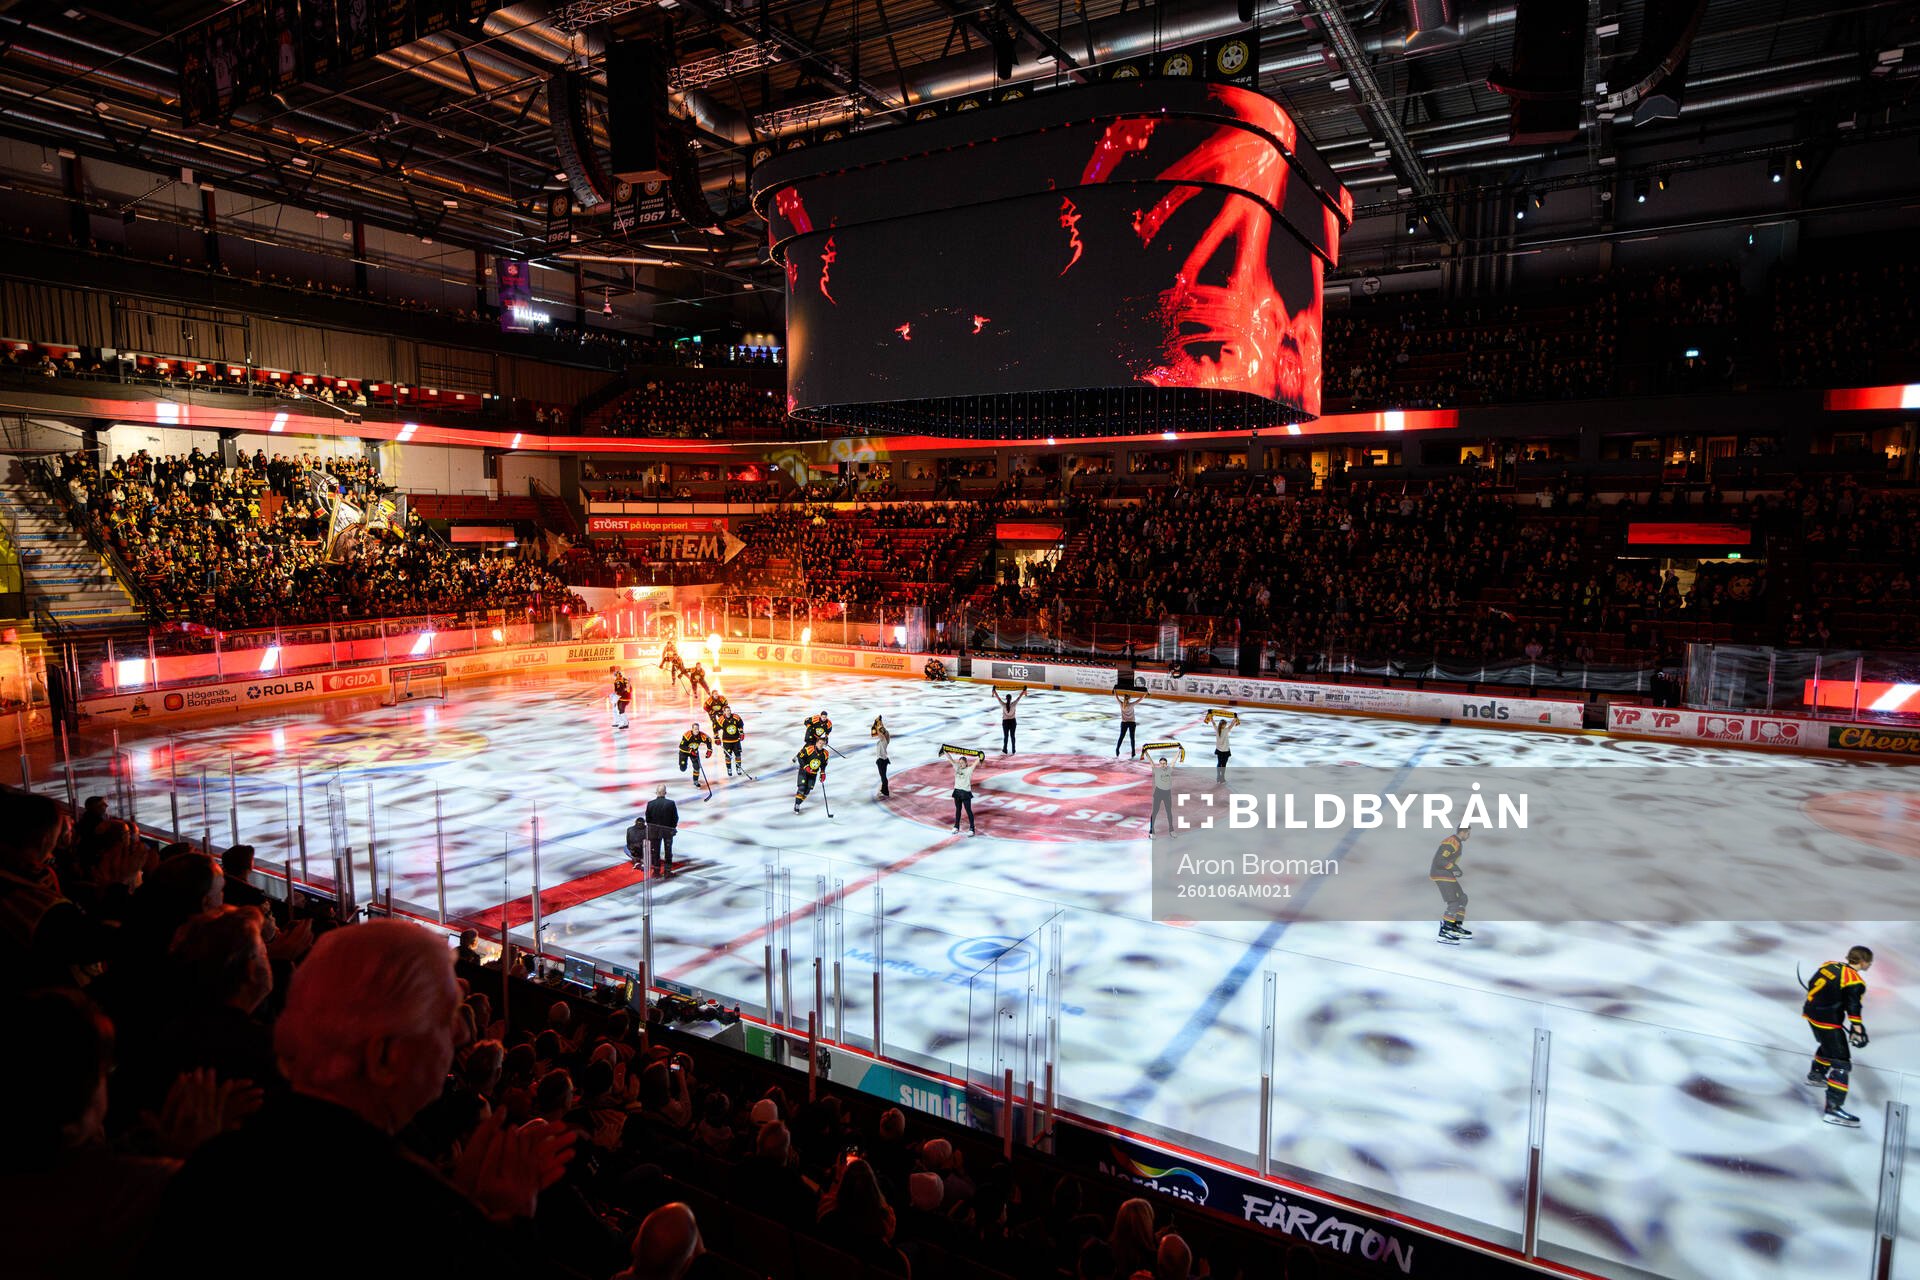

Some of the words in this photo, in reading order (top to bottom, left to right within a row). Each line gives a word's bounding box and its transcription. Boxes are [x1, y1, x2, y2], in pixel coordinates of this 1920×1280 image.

[639, 210, 666, 223] 1967
[612, 217, 636, 231] 1966
[593, 518, 629, 529] STÖRST
[630, 519, 641, 531] på
[643, 519, 662, 531] låga
[1008, 667, 1029, 677] NKB
[345, 673, 376, 687] GIDA
[187, 689, 230, 701] Höganäs
[263, 681, 315, 697] ROLBA
[1150, 679, 1178, 691] EN
[1185, 682, 1231, 695] BRA
[1241, 684, 1320, 702] START
[187, 695, 237, 707] Borgestad
[1463, 700, 1509, 720] nds
[1242, 1194, 1413, 1274] FÄRGTON
